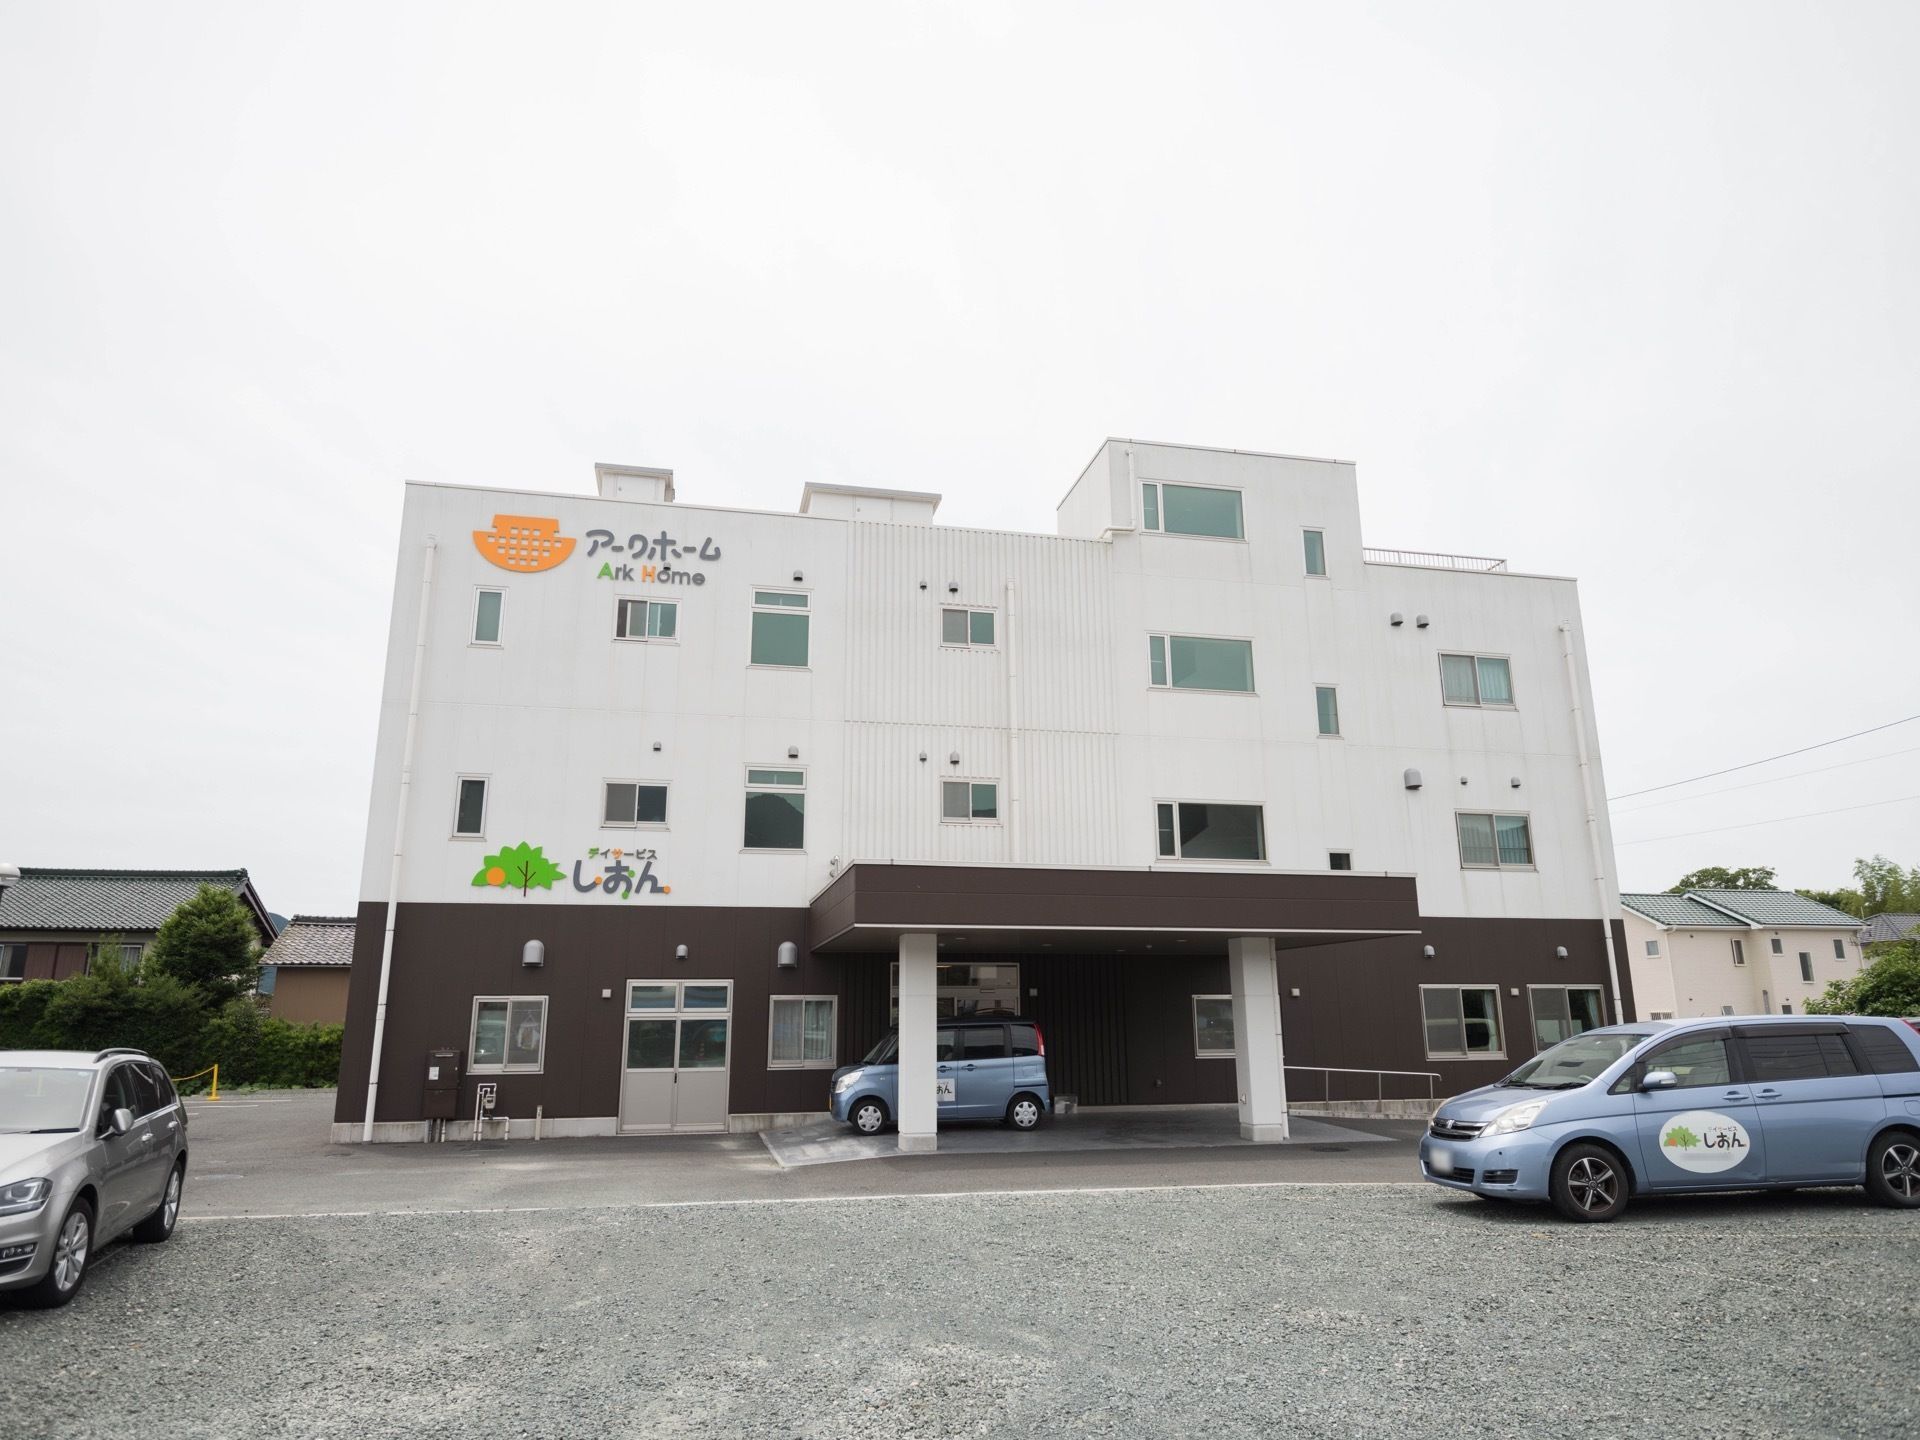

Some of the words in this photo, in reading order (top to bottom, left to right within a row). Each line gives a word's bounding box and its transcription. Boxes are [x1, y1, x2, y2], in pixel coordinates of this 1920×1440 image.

[586, 529, 721, 561] アークホーム
[597, 562, 634, 582] Ark
[641, 564, 706, 586] Home
[588, 847, 658, 860] デイサービス
[573, 859, 671, 899] しおん
[936, 1084, 952, 1095] おん
[1703, 1132, 1747, 1150] しおん
